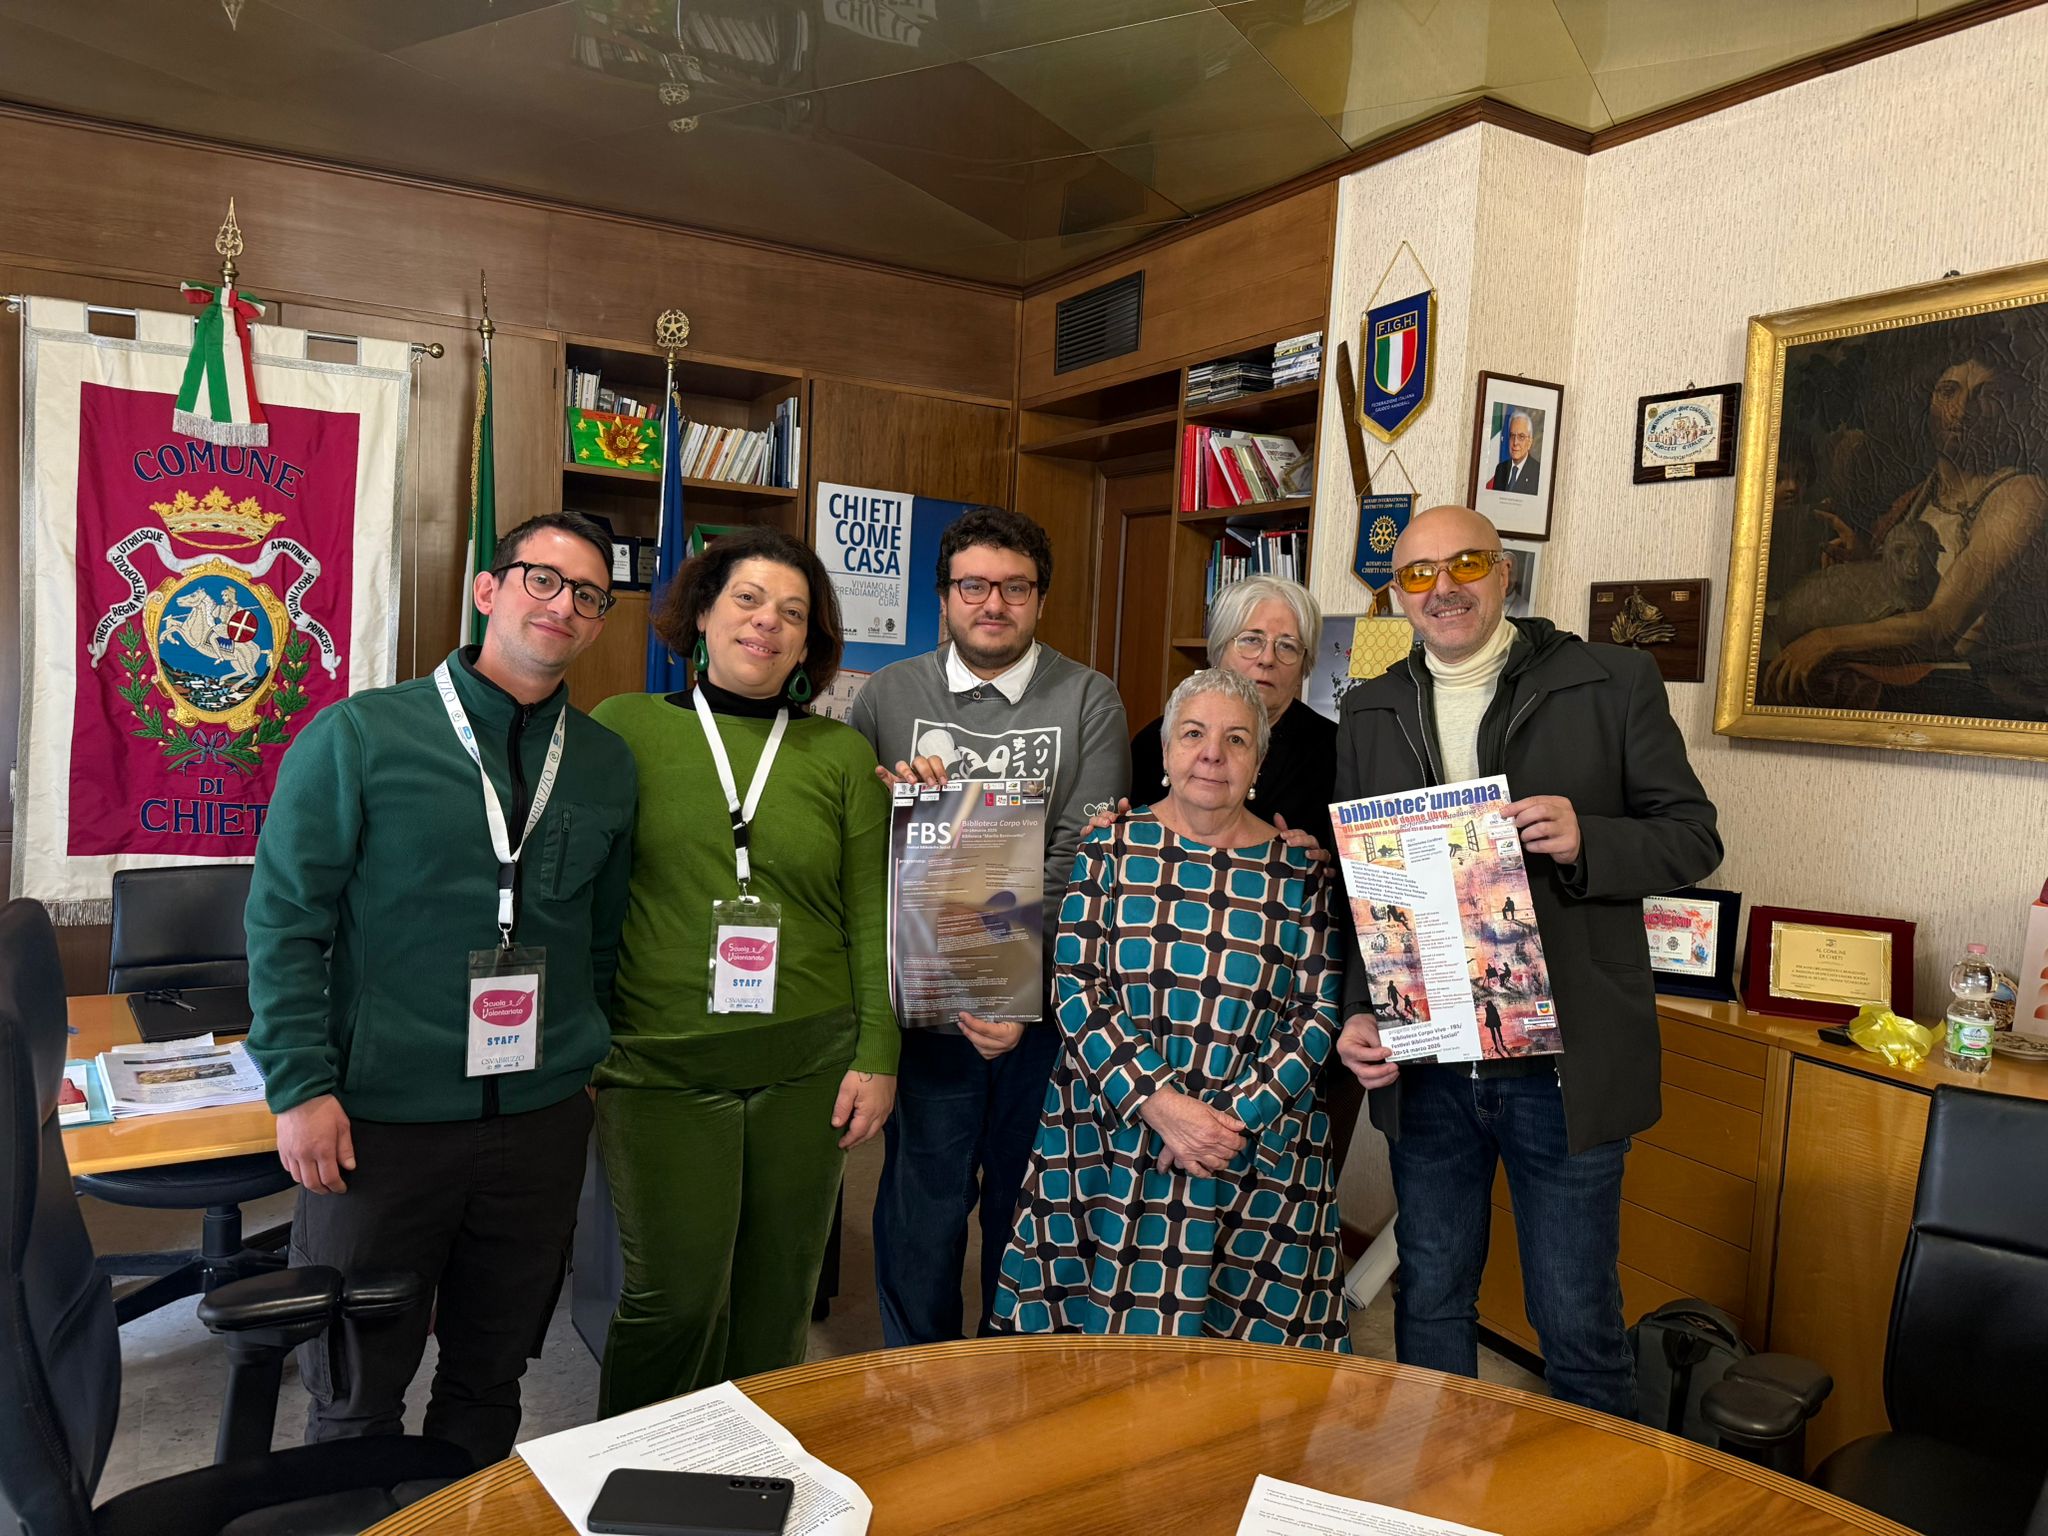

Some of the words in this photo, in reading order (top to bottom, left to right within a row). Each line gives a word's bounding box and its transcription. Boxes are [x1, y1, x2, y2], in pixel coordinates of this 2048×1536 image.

[1378, 315, 1415, 335] F.I.G.H.
[133, 441, 304, 499] COMUNE
[829, 493, 901, 525] CHIETI
[117, 529, 165, 554] UTRIUSQUE
[836, 520, 902, 550] COME
[844, 546, 900, 576] CASA
[852, 580, 894, 592] VIVIAMOLA
[895, 583, 900, 593] E
[112, 602, 138, 617] REGIA
[878, 598, 900, 607] CURA
[96, 613, 118, 644] THEATE
[305, 621, 333, 655] PRINCEPS
[198, 777, 224, 795] DI
[1337, 783, 1501, 825] bibliotec'umana
[140, 798, 269, 836] CHIET
[1000, 820, 1020, 828] Corpo
[1022, 819, 1038, 827] Vivo
[907, 822, 952, 844] FBS
[728, 943, 749, 953] Scuola
[733, 979, 762, 987] STAFF
[483, 998, 506, 1008] Scuola
[482, 1008, 523, 1019] Volontariato
[487, 1035, 520, 1046] STAFF
